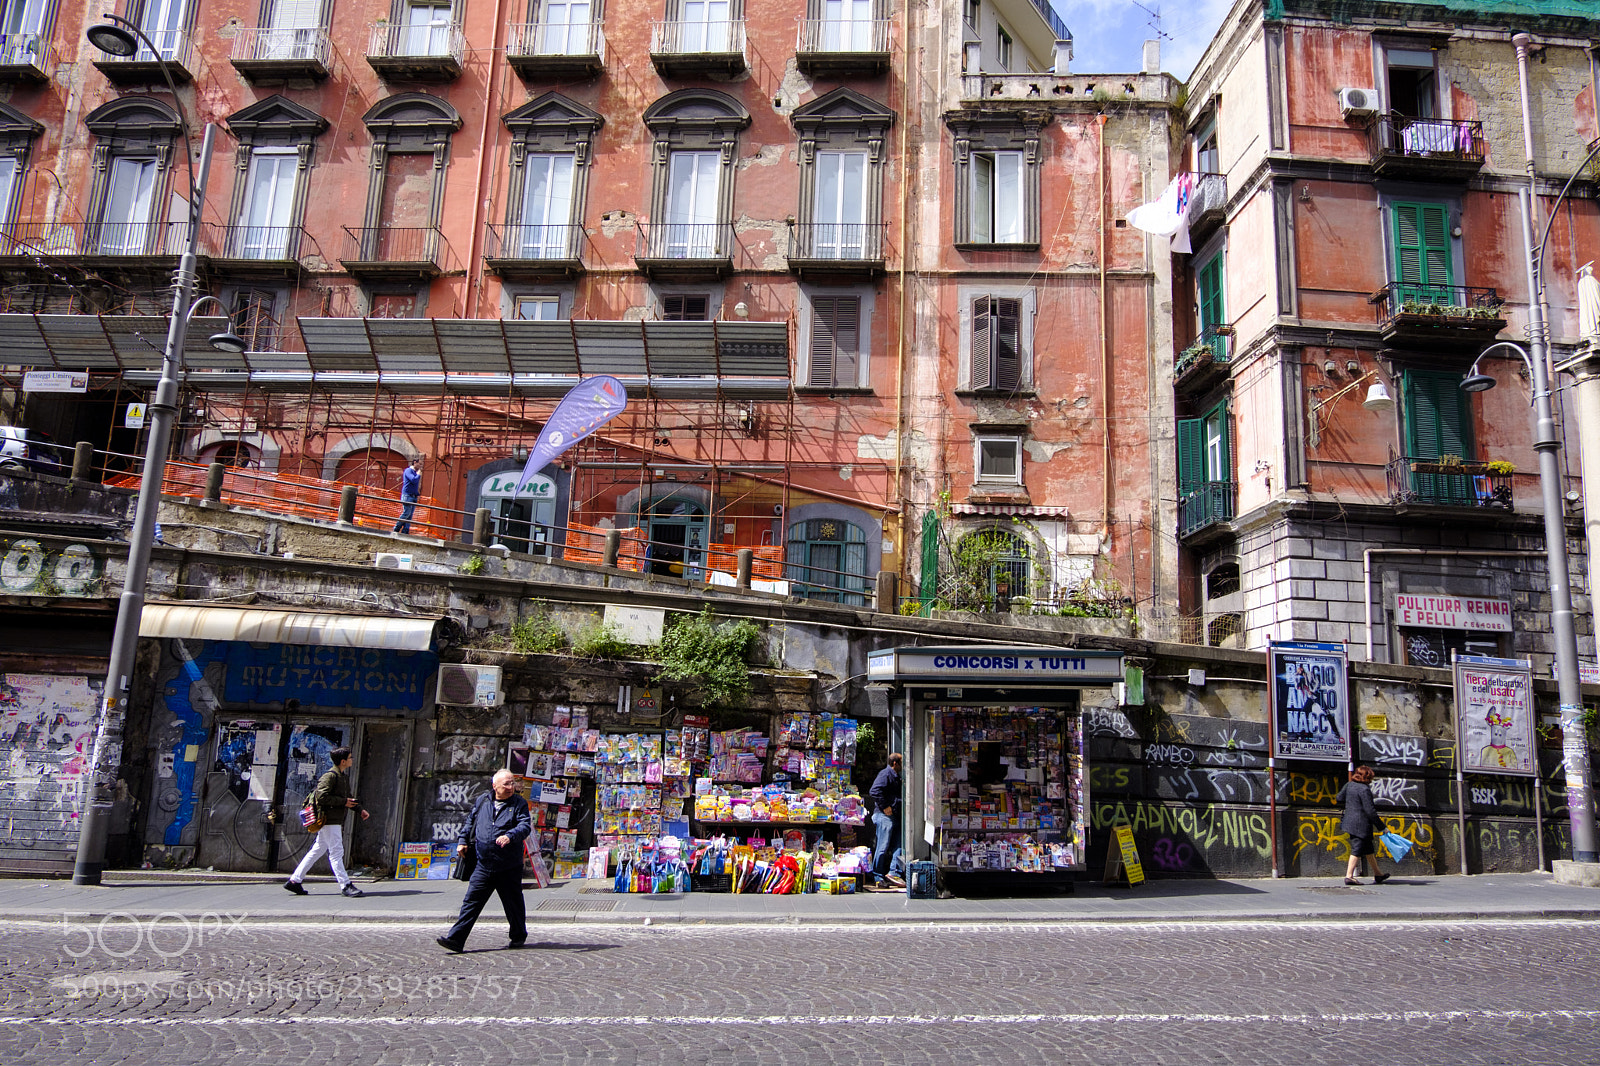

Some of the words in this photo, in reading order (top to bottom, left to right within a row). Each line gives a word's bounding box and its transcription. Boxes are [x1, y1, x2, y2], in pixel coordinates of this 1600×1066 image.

[1397, 596, 1462, 613] PULITURA
[1466, 600, 1510, 616] RENNA
[1403, 610, 1412, 623] E
[1417, 611, 1456, 627] PELLI
[280, 645, 381, 668] MICRO
[934, 656, 1019, 669] CONCORSI
[1024, 659, 1034, 670] x
[1039, 657, 1086, 670] TUTTI
[242, 666, 418, 693] MUTAZIONI
[1465, 673, 1487, 686] fiera
[1488, 677, 1499, 686] del
[1499, 678, 1524, 688] baratto
[1491, 687, 1516, 697] usato
[440, 784, 469, 804] BSK
[1471, 787, 1498, 805] BSK
[432, 822, 461, 840] BSK
